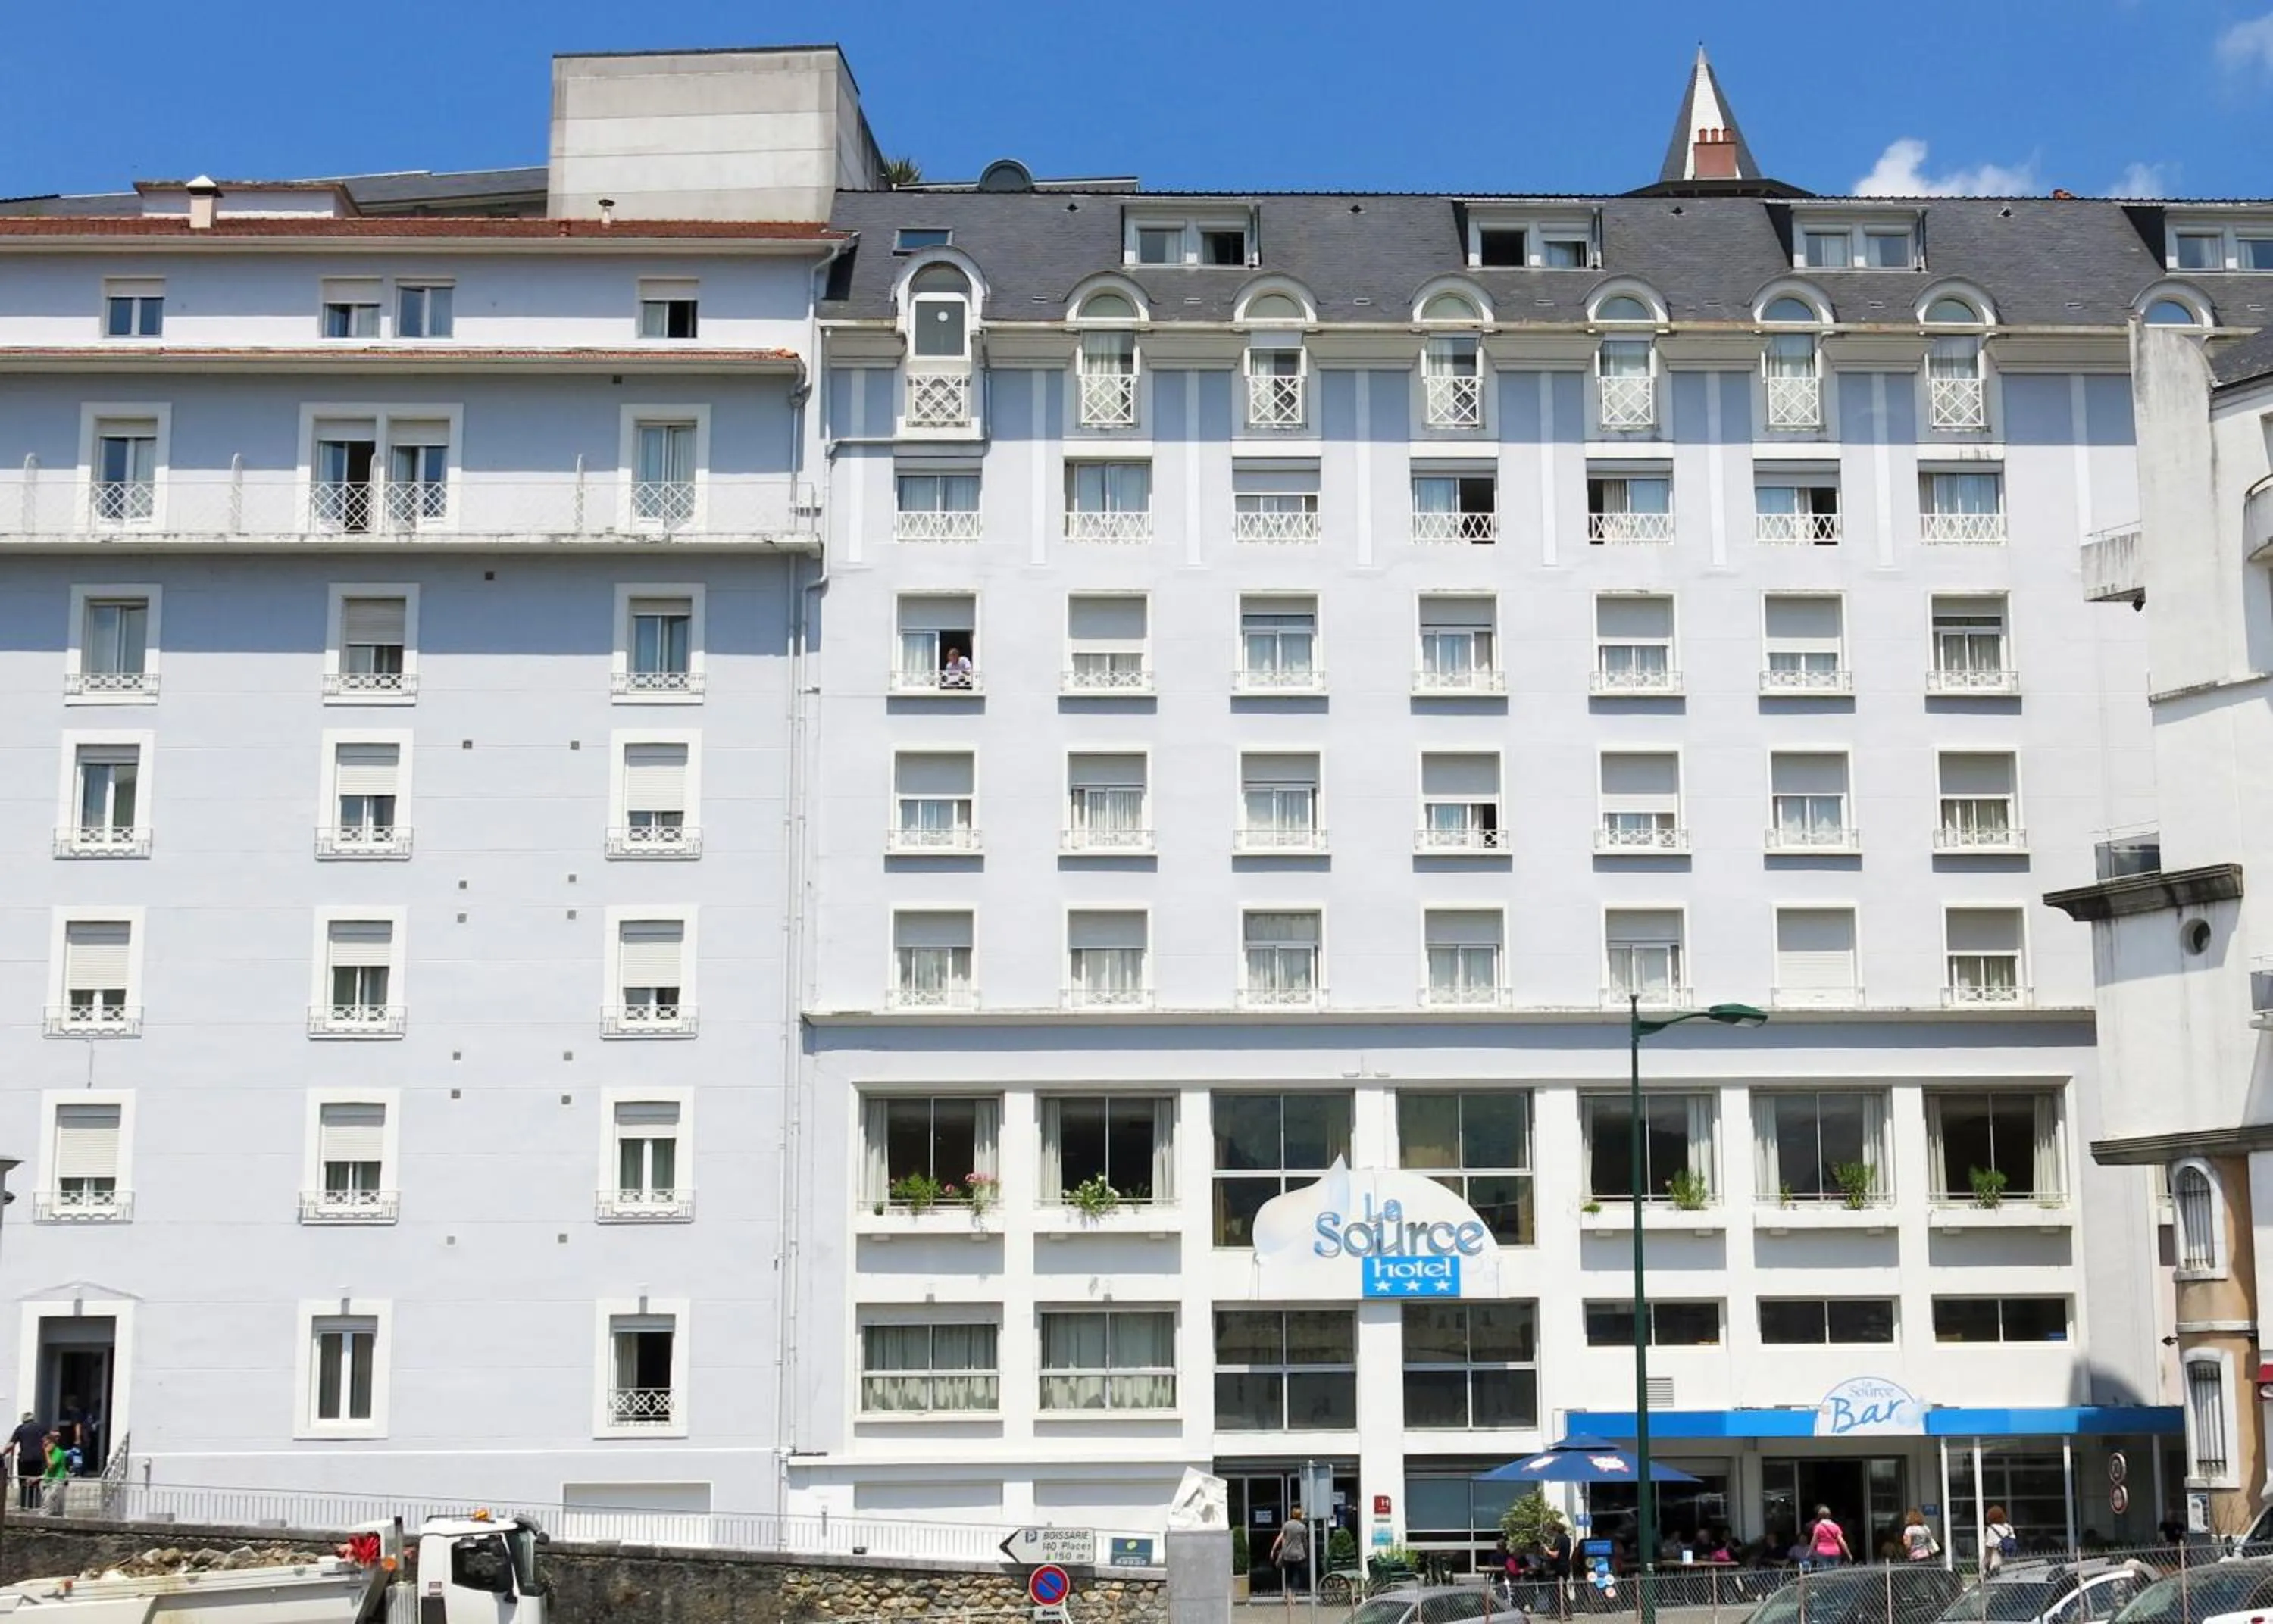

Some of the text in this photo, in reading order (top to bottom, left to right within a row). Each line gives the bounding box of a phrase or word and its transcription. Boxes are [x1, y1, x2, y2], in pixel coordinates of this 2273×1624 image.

[1365, 1193, 1402, 1222] La
[1314, 1211, 1484, 1258] Source
[1372, 1257, 1452, 1278] hotel
[1849, 1385, 1894, 1398] Source
[1830, 1398, 1906, 1433] Bar
[1043, 1531, 1089, 1539] BOISSARIE
